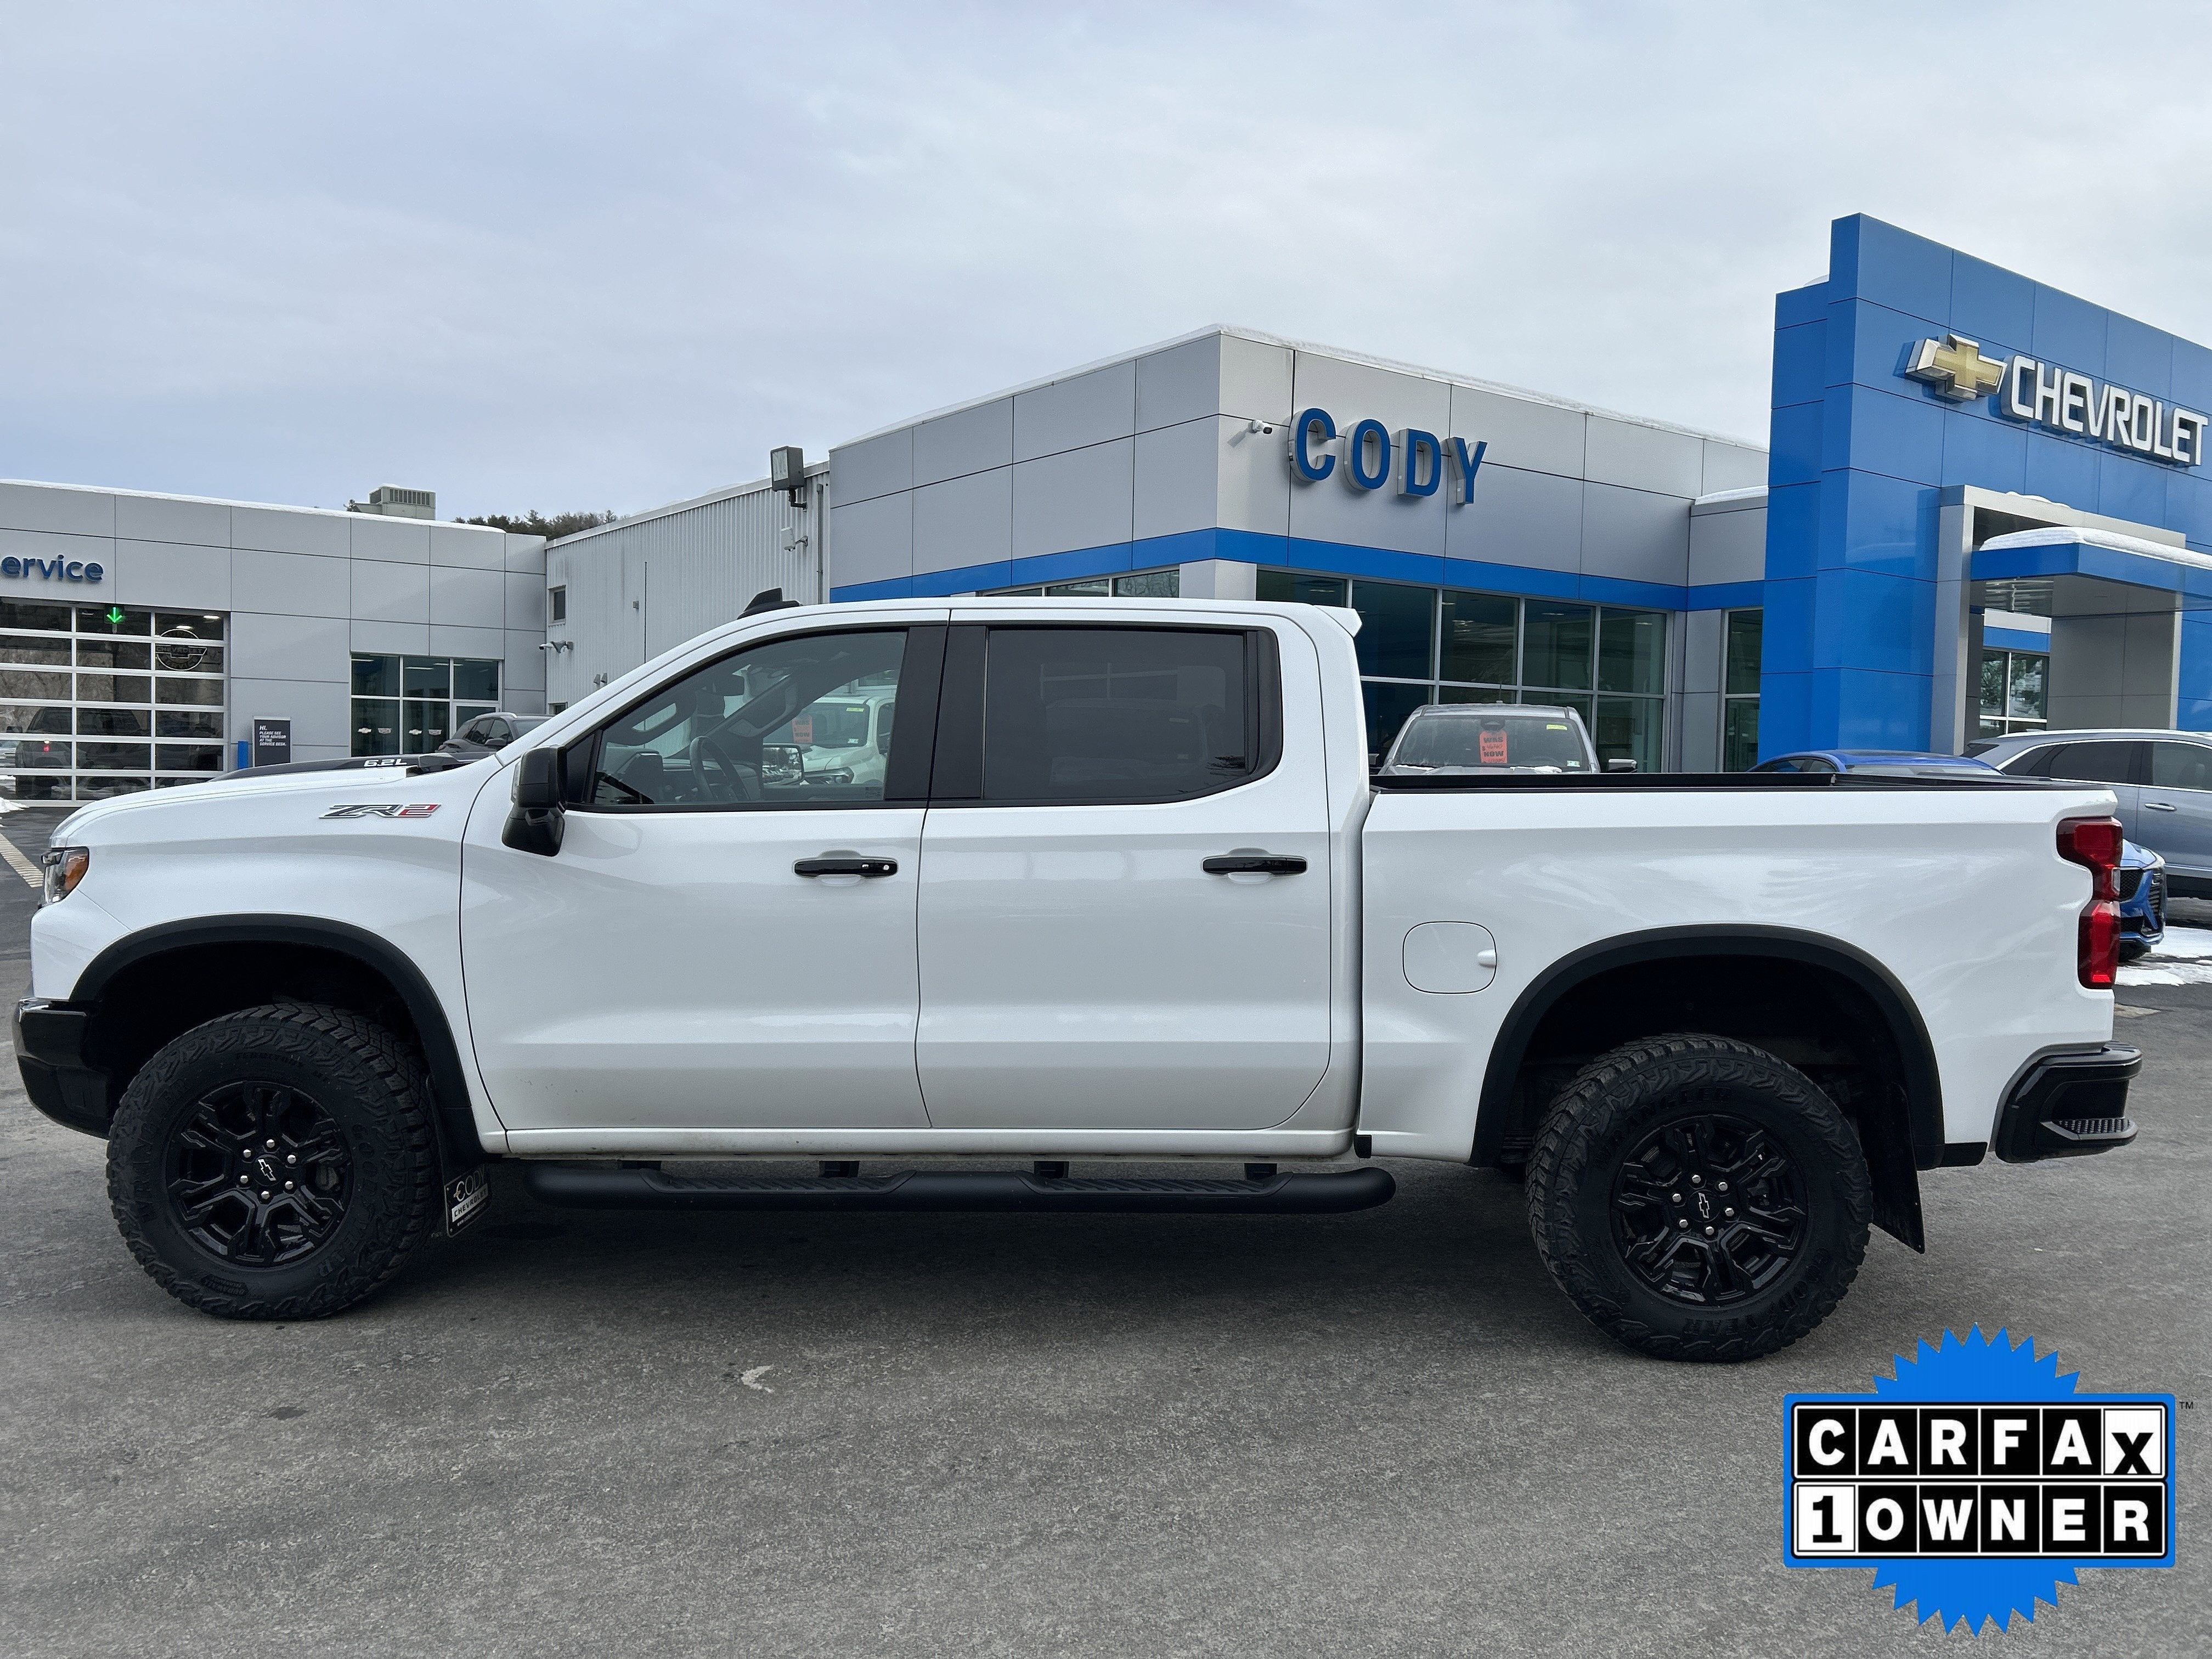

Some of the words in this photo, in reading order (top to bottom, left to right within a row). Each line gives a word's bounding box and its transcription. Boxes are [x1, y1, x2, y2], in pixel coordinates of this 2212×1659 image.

[2002, 355, 2209, 466] CHEVROLET
[1289, 408, 1488, 505] CODY
[0, 554, 104, 582] ervice
[364, 758, 407, 767] 6.2L
[318, 804, 441, 819] ZR2
[454, 1164, 485, 1201] CODY
[454, 1188, 487, 1217] CHEVROLET
